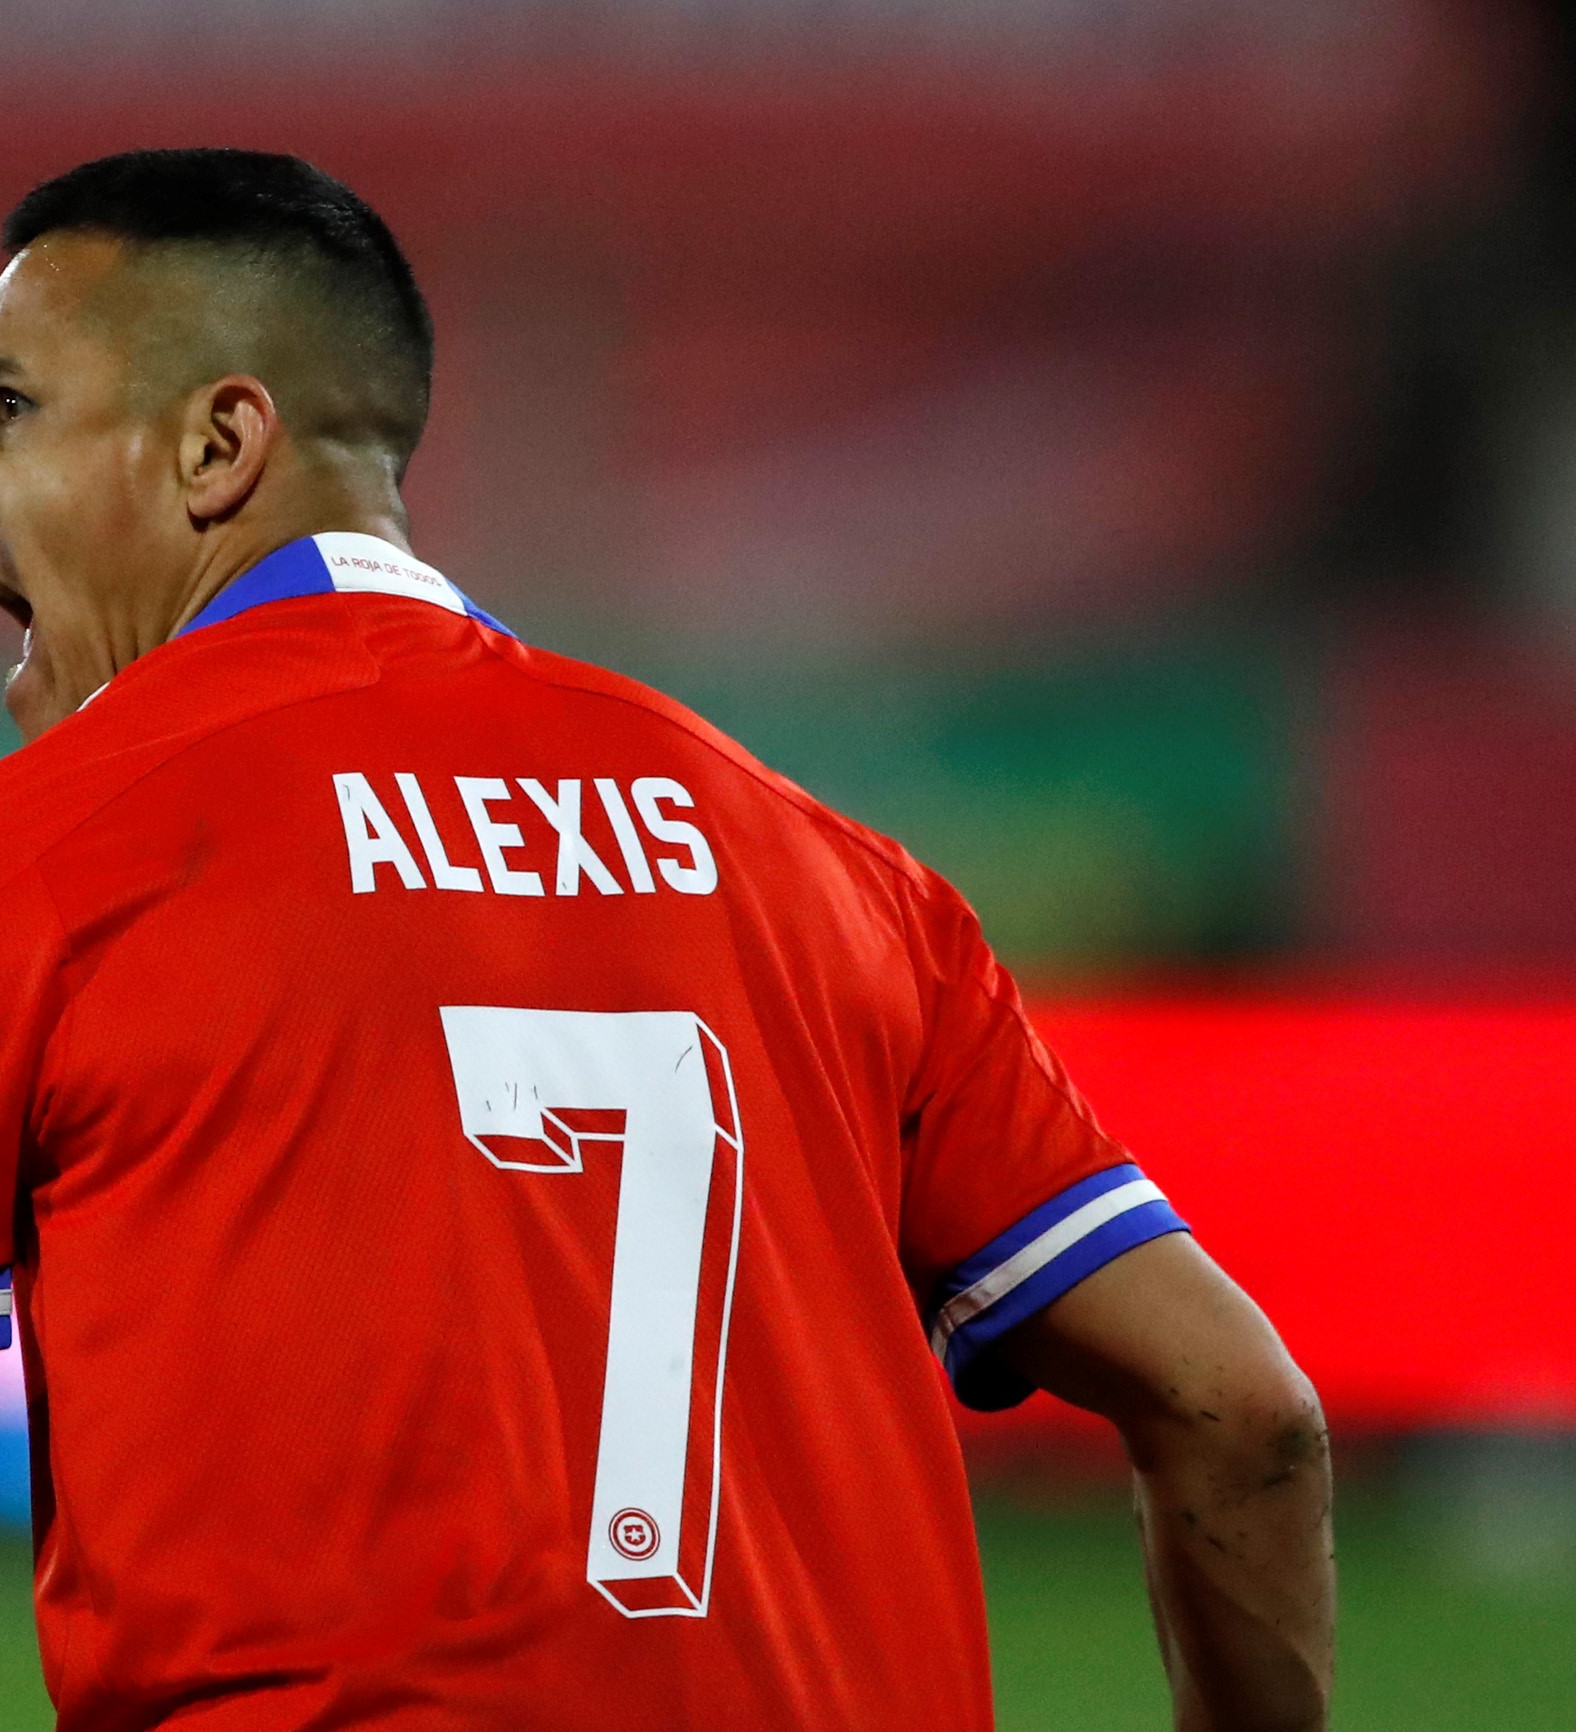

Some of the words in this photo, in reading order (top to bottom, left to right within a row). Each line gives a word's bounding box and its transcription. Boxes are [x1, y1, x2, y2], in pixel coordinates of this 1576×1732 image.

[331, 556, 350, 567] LA
[351, 557, 383, 573] ROJA
[384, 563, 402, 576] DE
[332, 772, 719, 897] ALEXIS
[439, 1006, 743, 1618] 7
